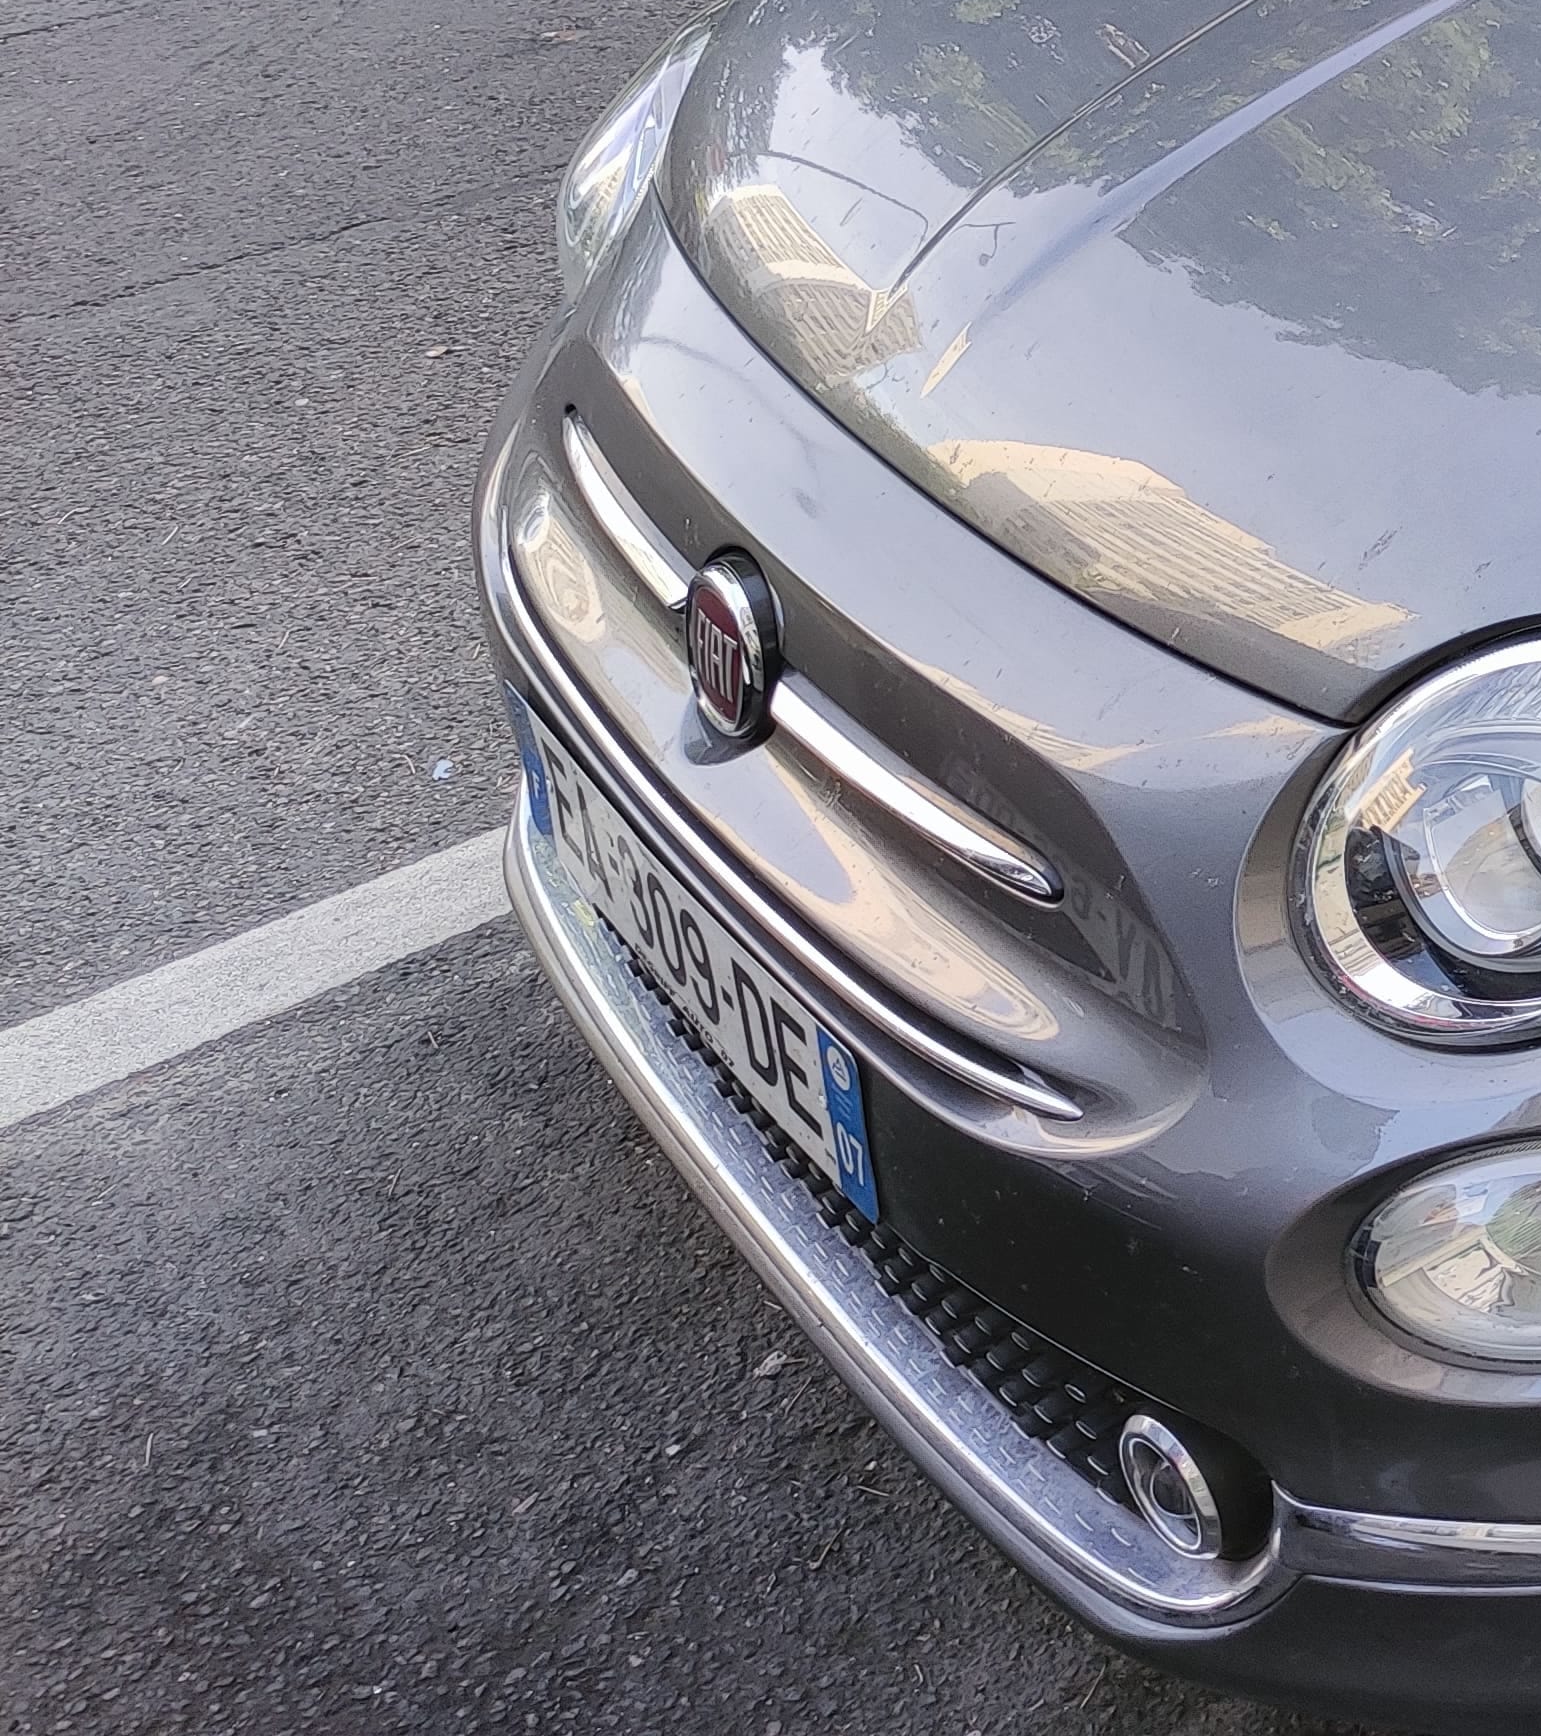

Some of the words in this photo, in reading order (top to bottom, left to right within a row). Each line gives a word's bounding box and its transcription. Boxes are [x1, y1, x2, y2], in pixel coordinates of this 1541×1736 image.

[698, 608, 738, 703] FIAT
[541, 737, 824, 1141] EA-309-DE
[836, 1121, 865, 1187] 07
